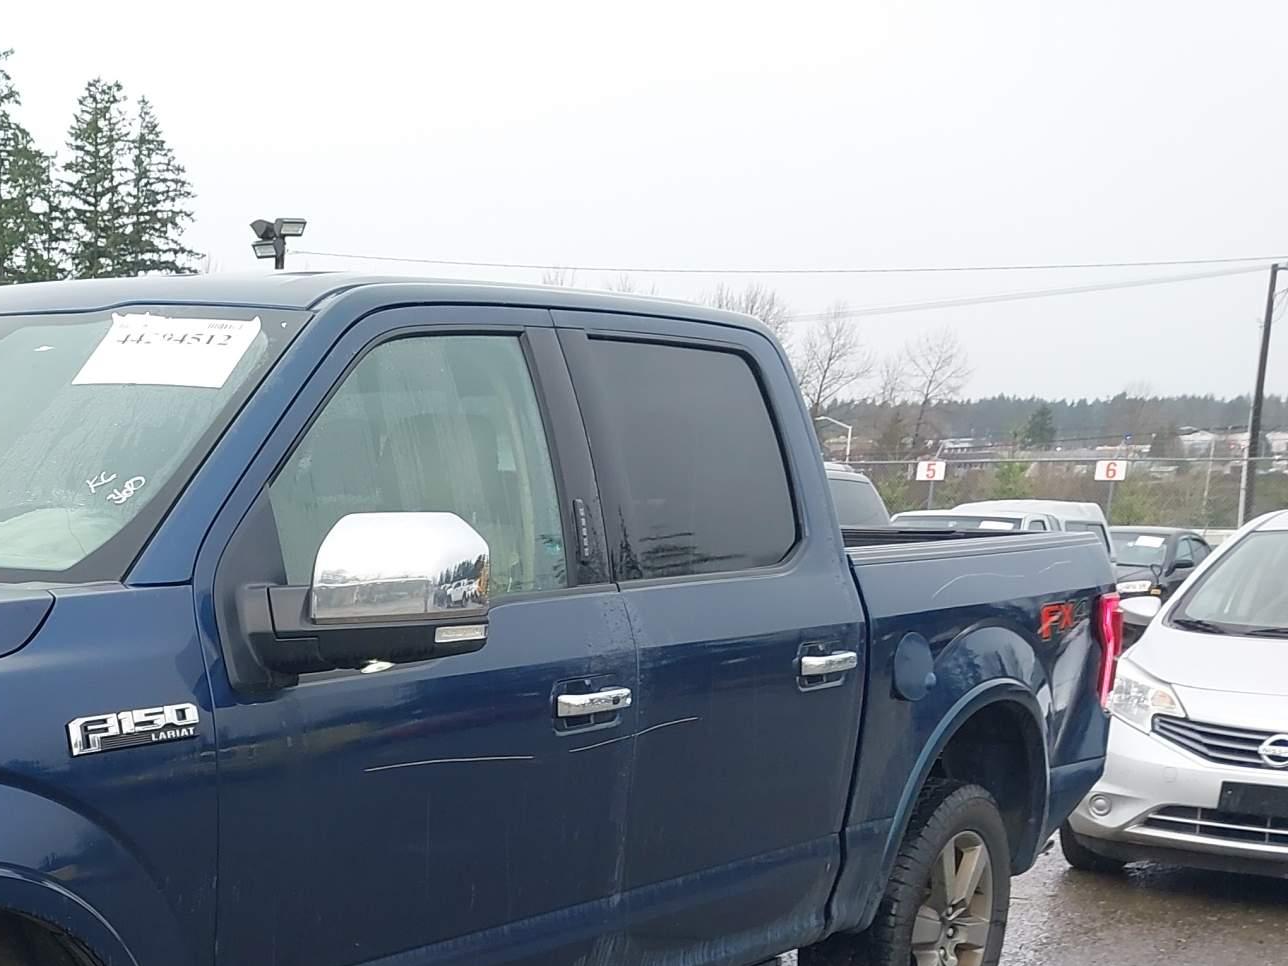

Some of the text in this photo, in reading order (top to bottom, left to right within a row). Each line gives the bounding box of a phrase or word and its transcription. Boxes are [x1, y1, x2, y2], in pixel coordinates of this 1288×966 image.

[925, 463, 936, 479] 5
[1105, 463, 1117, 479] 6
[151, 726, 196, 742] LARIAT
